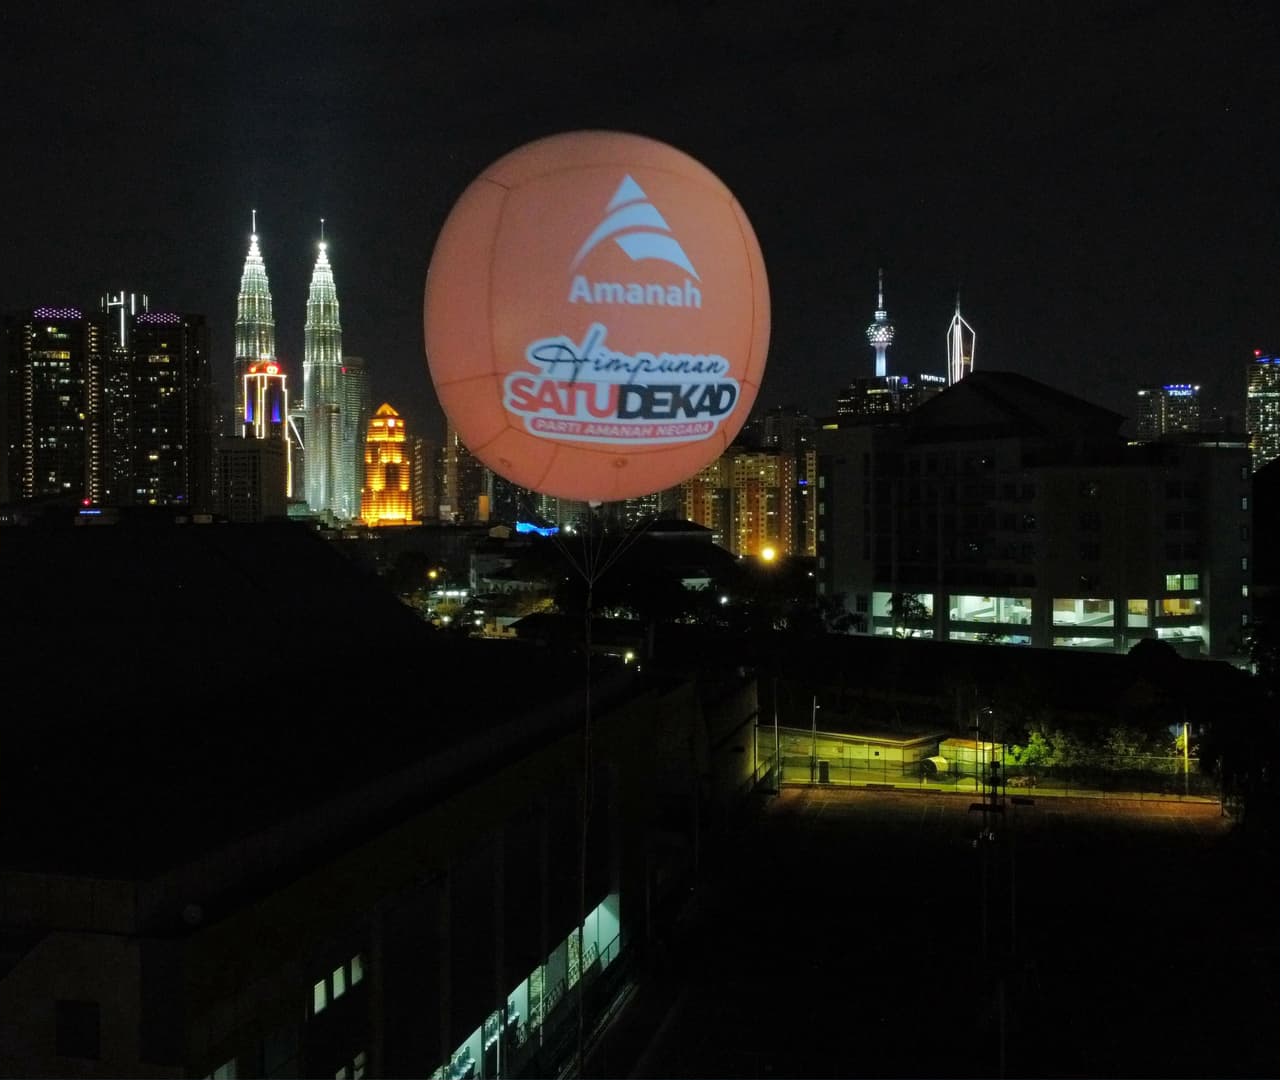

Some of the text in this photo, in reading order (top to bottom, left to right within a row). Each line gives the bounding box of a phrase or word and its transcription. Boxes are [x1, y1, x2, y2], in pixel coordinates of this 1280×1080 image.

[568, 275, 702, 308] Amanah
[531, 326, 725, 387] Himpunan
[535, 419, 709, 438] PARTI AMANAH NEGARA
